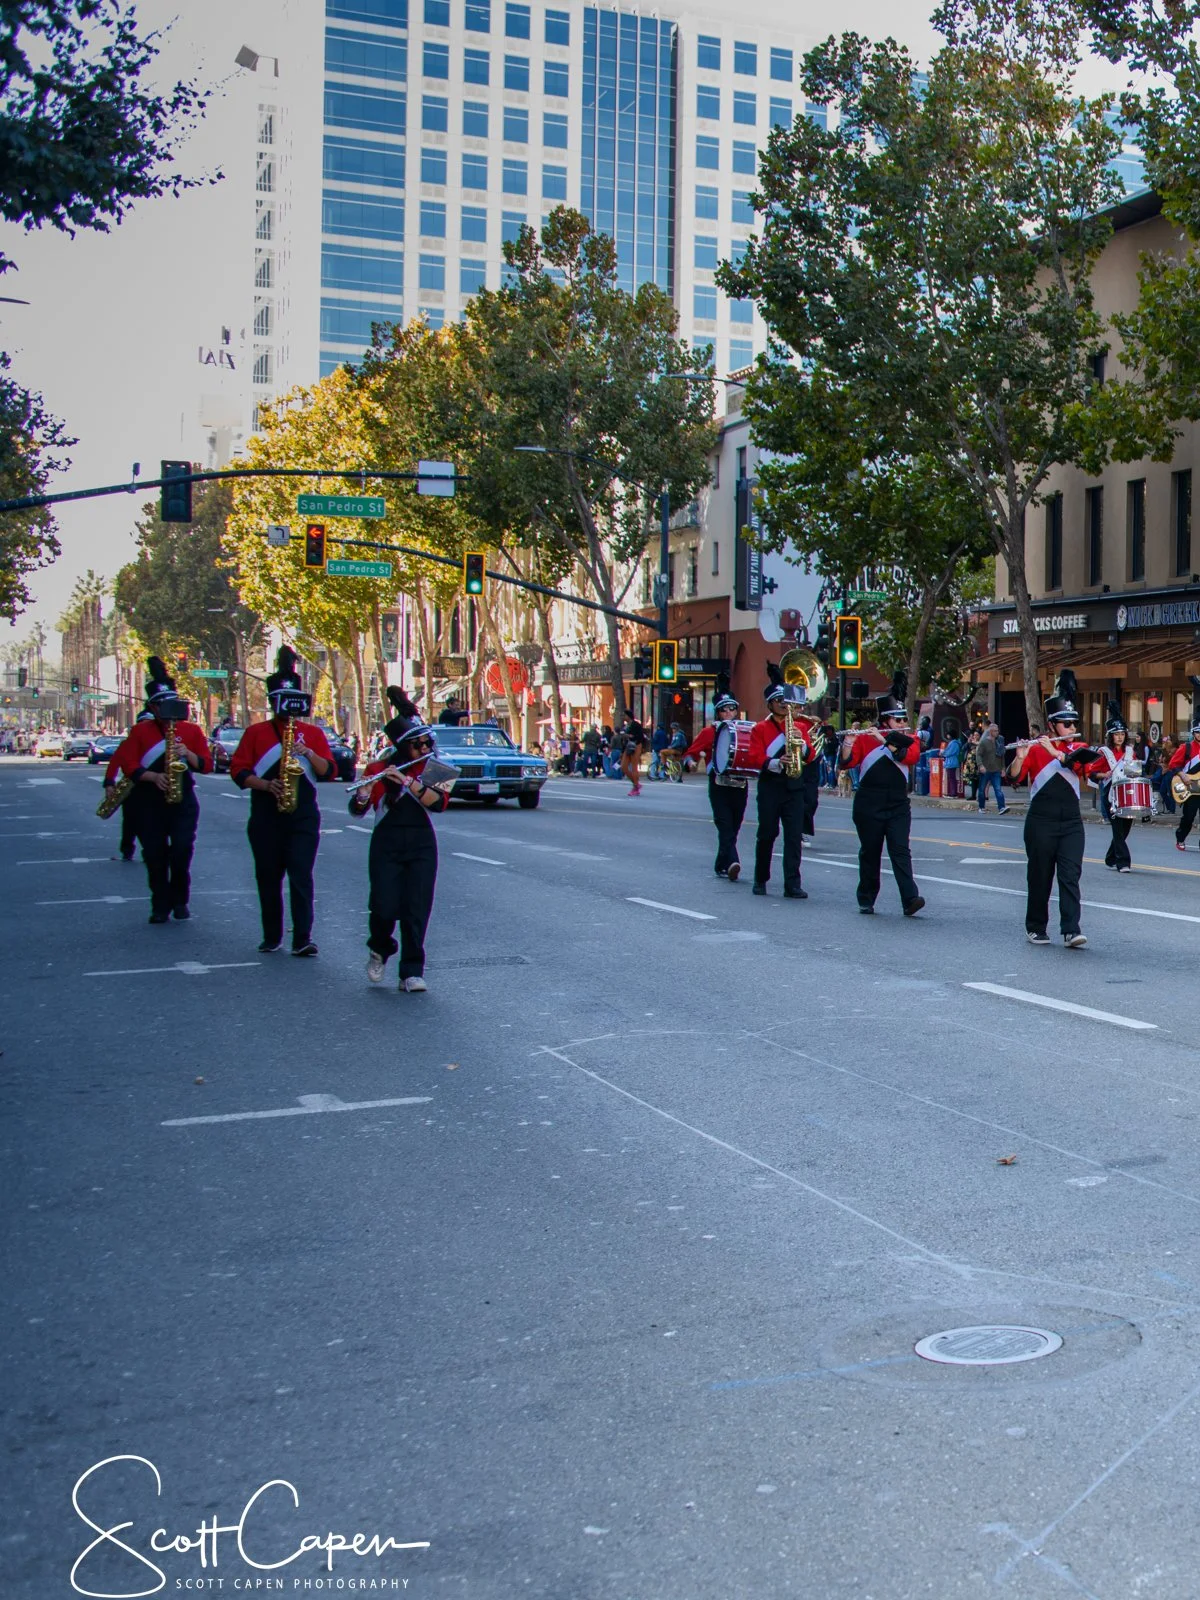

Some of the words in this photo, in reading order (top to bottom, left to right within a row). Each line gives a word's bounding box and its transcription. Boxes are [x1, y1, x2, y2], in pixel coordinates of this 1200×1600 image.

[300, 500, 323, 511] San
[328, 501, 364, 512] Pedro
[368, 502, 382, 513] St
[329, 563, 346, 572] San
[349, 564, 376, 574] Pedro
[378, 566, 389, 574] St
[750, 575, 759, 596] THE
[1161, 601, 1200, 625] GREEK
[1003, 616, 1051, 634] STACKS
[1051, 614, 1088, 630] COFFEE
